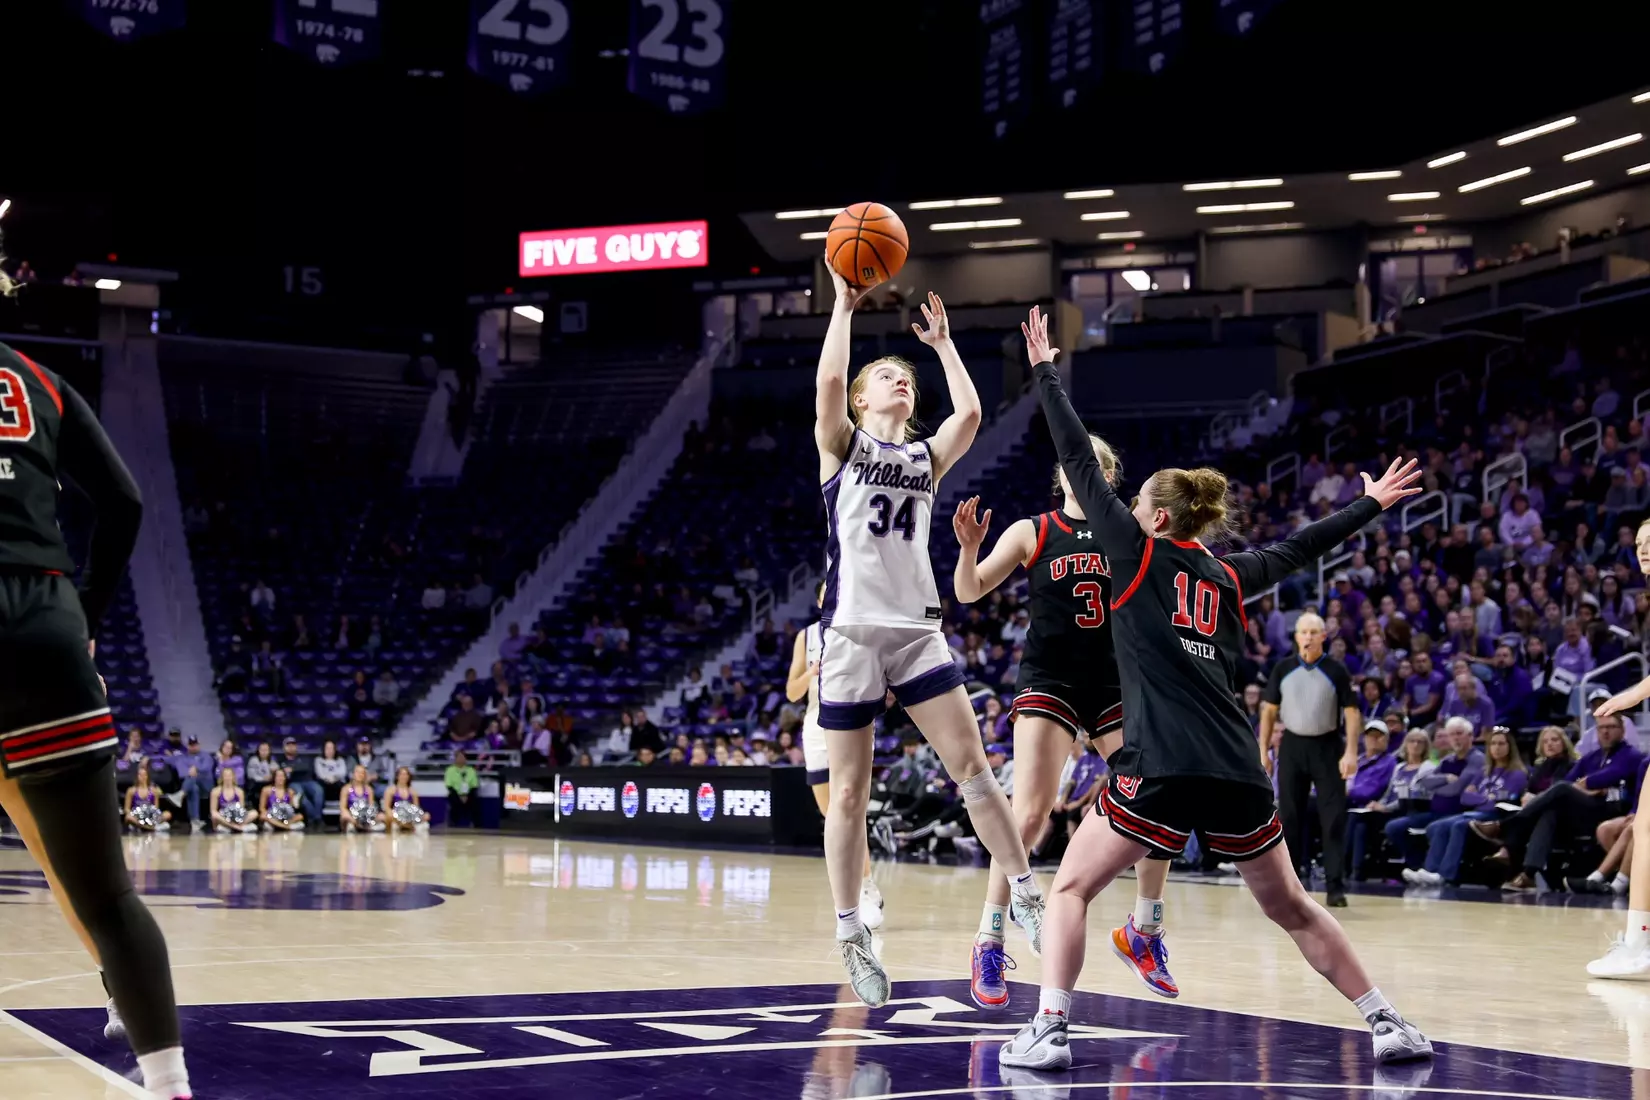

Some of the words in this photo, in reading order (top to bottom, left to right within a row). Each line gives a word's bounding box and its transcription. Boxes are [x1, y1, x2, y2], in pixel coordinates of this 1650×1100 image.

[637, 0, 725, 68] 23
[523, 236, 598, 268] FIVE
[604, 229, 700, 263] GUYS
[282, 264, 323, 296] 15
[853, 461, 932, 494] Wildcats
[868, 492, 916, 541] 34
[1072, 581, 1105, 629] 3
[1171, 571, 1220, 637] 10
[1180, 637, 1215, 661] FOSTER
[577, 787, 615, 811] PEPSI
[645, 788, 689, 814] PEPSI
[722, 789, 771, 817] PEPSI
